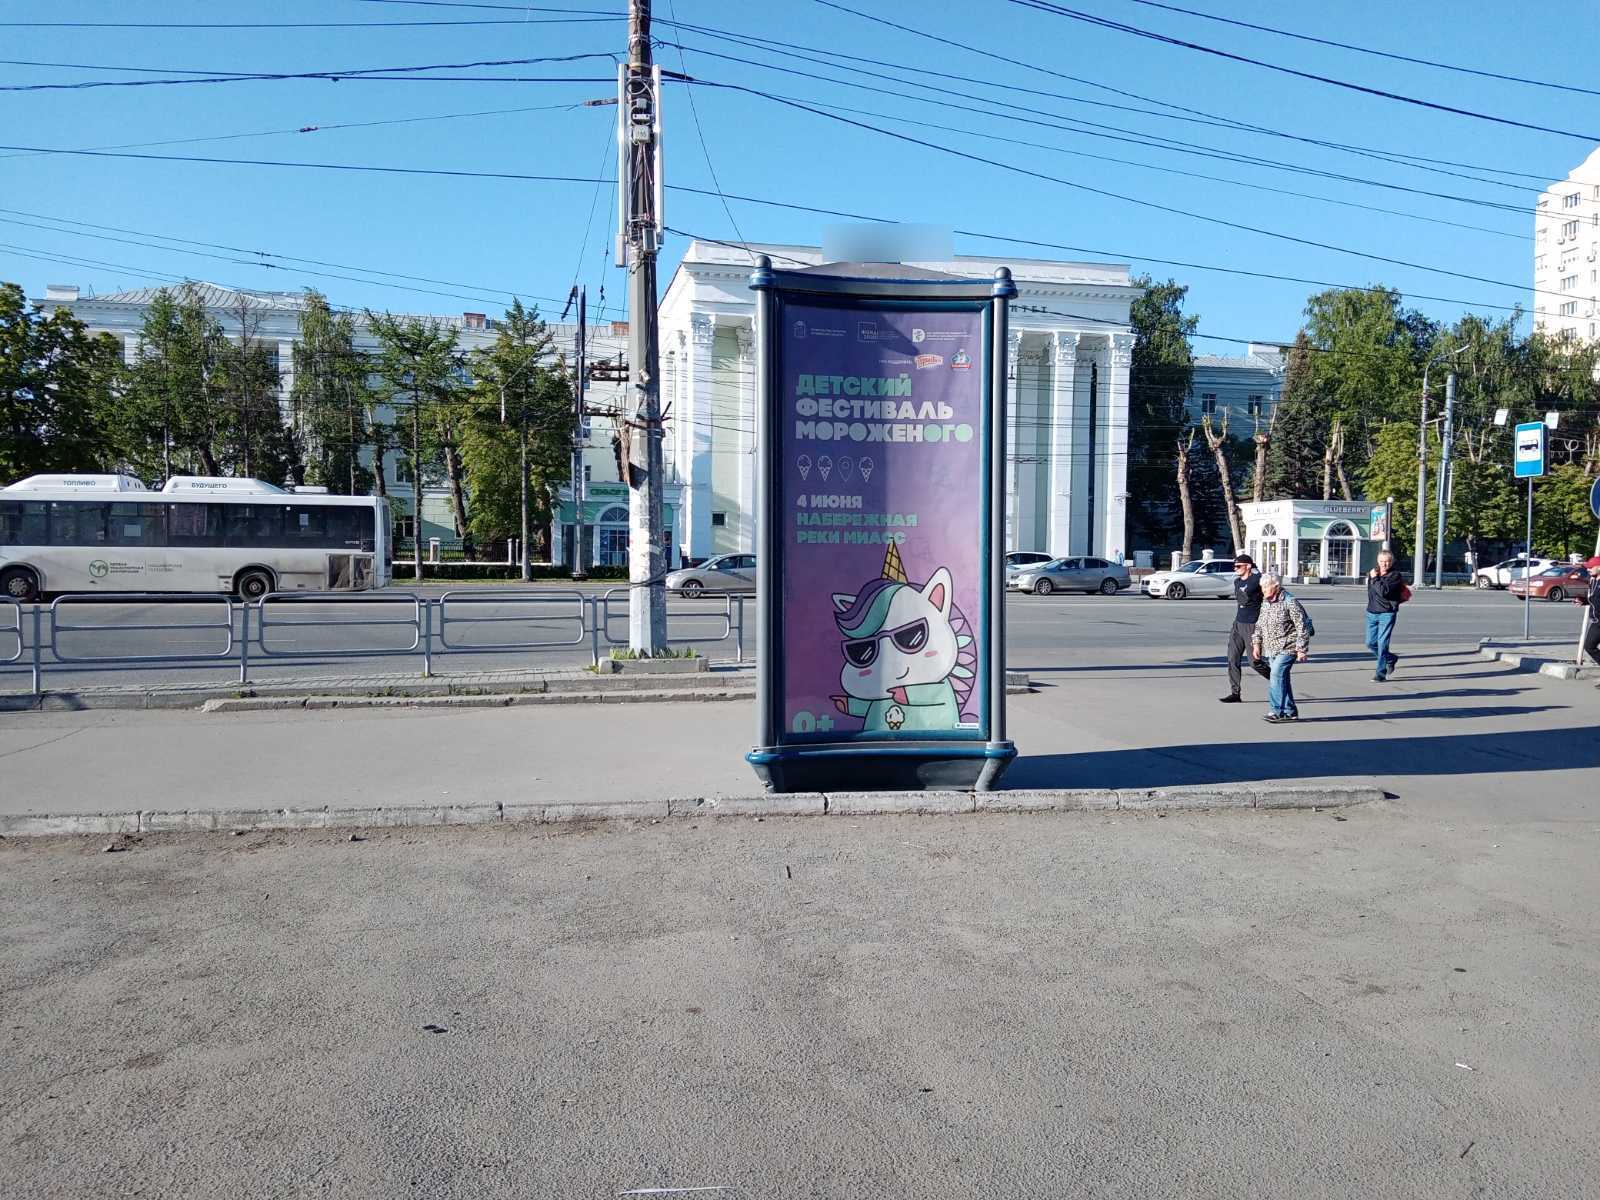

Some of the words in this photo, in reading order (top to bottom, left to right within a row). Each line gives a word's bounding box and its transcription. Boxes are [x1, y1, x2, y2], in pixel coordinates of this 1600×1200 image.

[796, 373, 912, 397] ДЕТСКИЙ
[795, 397, 954, 420] ФЕСТИВАЛЬ
[795, 420, 974, 443] МОРОЖЕНОГО
[63, 479, 96, 487] ТОПЛИВО
[796, 494, 807, 508] 4
[810, 494, 863, 509] ИЮНЯ
[796, 511, 919, 527] НАБЕРЕЖНАЯ
[796, 529, 840, 545] РЕКИ
[843, 530, 907, 545] МИАСС
[792, 710, 835, 733] 0+
